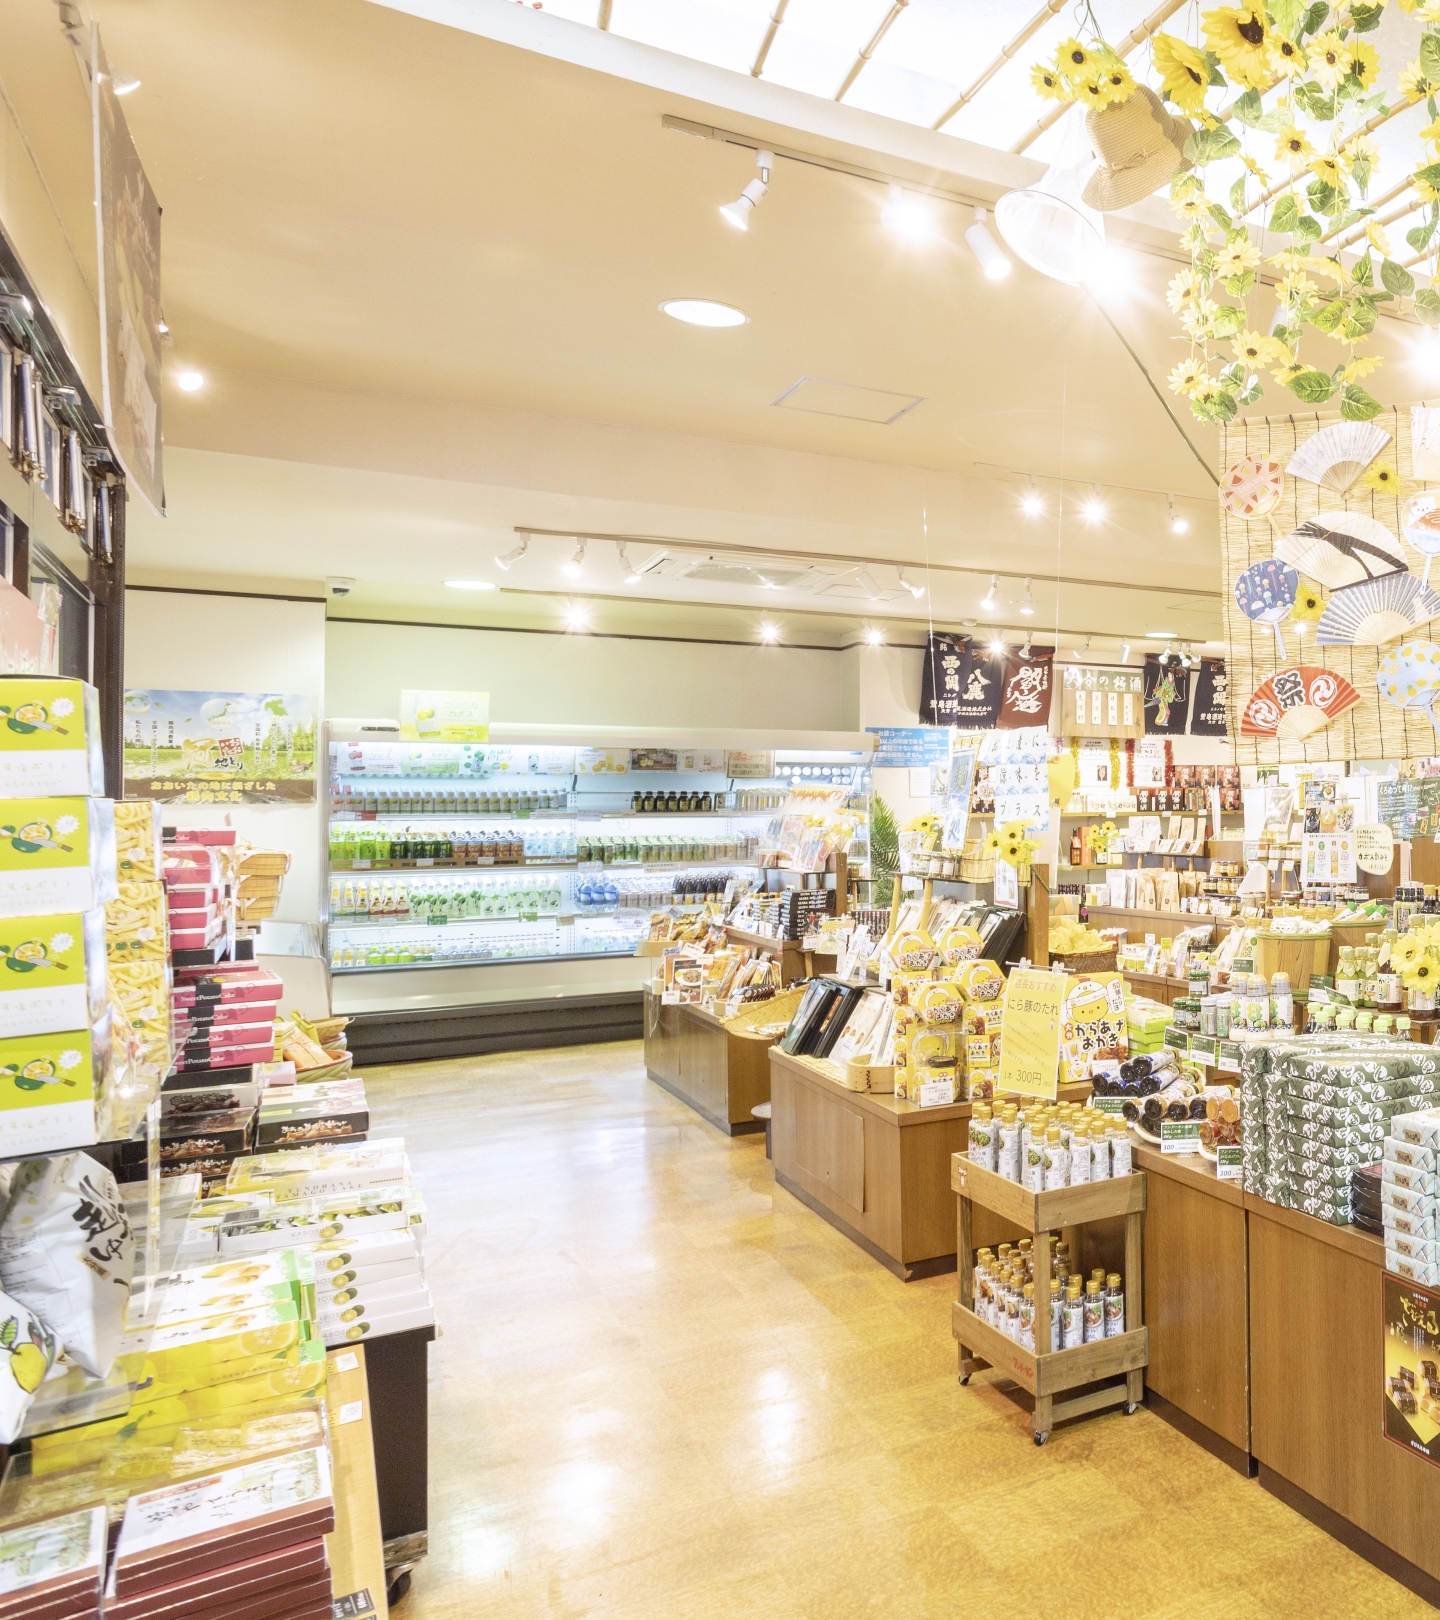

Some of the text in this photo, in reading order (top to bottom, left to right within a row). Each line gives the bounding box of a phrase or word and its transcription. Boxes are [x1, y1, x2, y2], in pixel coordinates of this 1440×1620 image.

[941, 655, 960, 692] 西の関
[962, 669, 991, 700] 八鹿
[1274, 670, 1305, 710] 祭
[1007, 998, 1059, 1016] にら豚のたれ
[1075, 1019, 1124, 1038] からあげ
[1082, 1033, 1119, 1051] おかき
[1016, 1069, 1042, 1086] 300円
